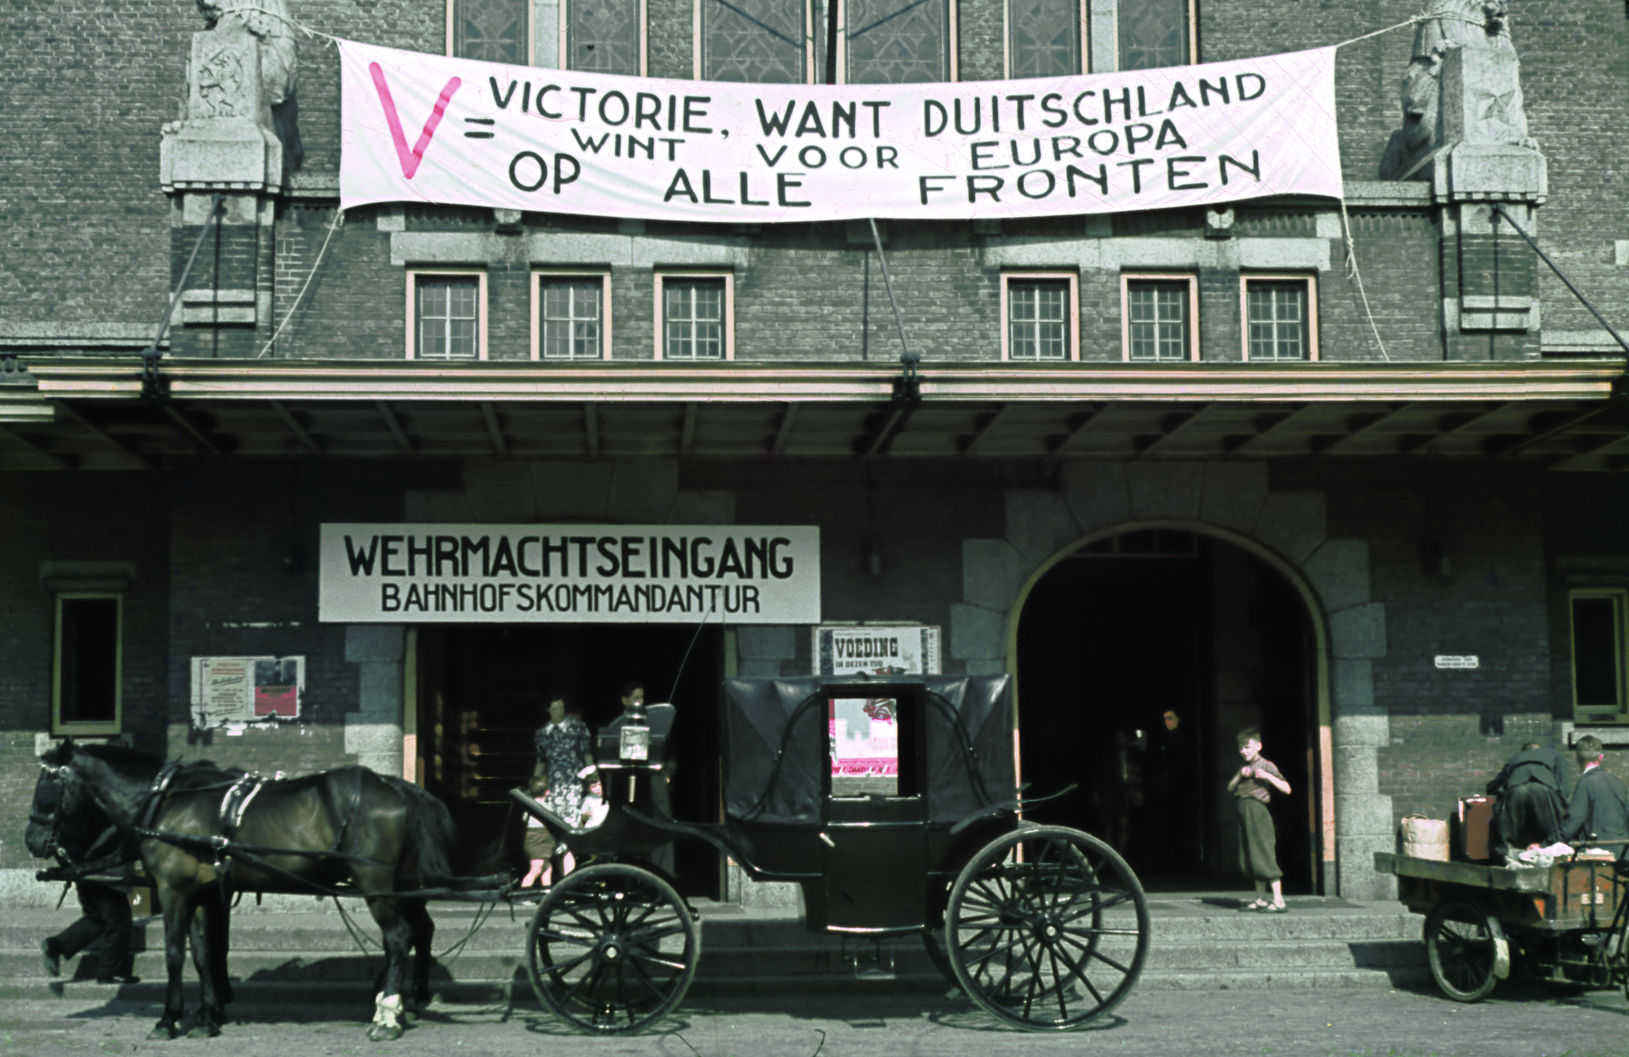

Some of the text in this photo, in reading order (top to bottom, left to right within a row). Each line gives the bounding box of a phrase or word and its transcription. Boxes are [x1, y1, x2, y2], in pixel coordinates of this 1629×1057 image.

[368, 61, 462, 180] V
[489, 76, 729, 139] VICTORIE,
[755, 98, 890, 138] WANT
[924, 73, 1266, 138] DUITSCHLAND
[571, 118, 1187, 171] WINT VOOR EUROPA
[508, 149, 1261, 207] OP ALLE FRONTEN
[343, 534, 794, 579] WEHRMACHTSEINGANG
[381, 583, 760, 613] BAHNHOFSKOMMANDANTUR
[835, 637, 898, 658] VOEDING
